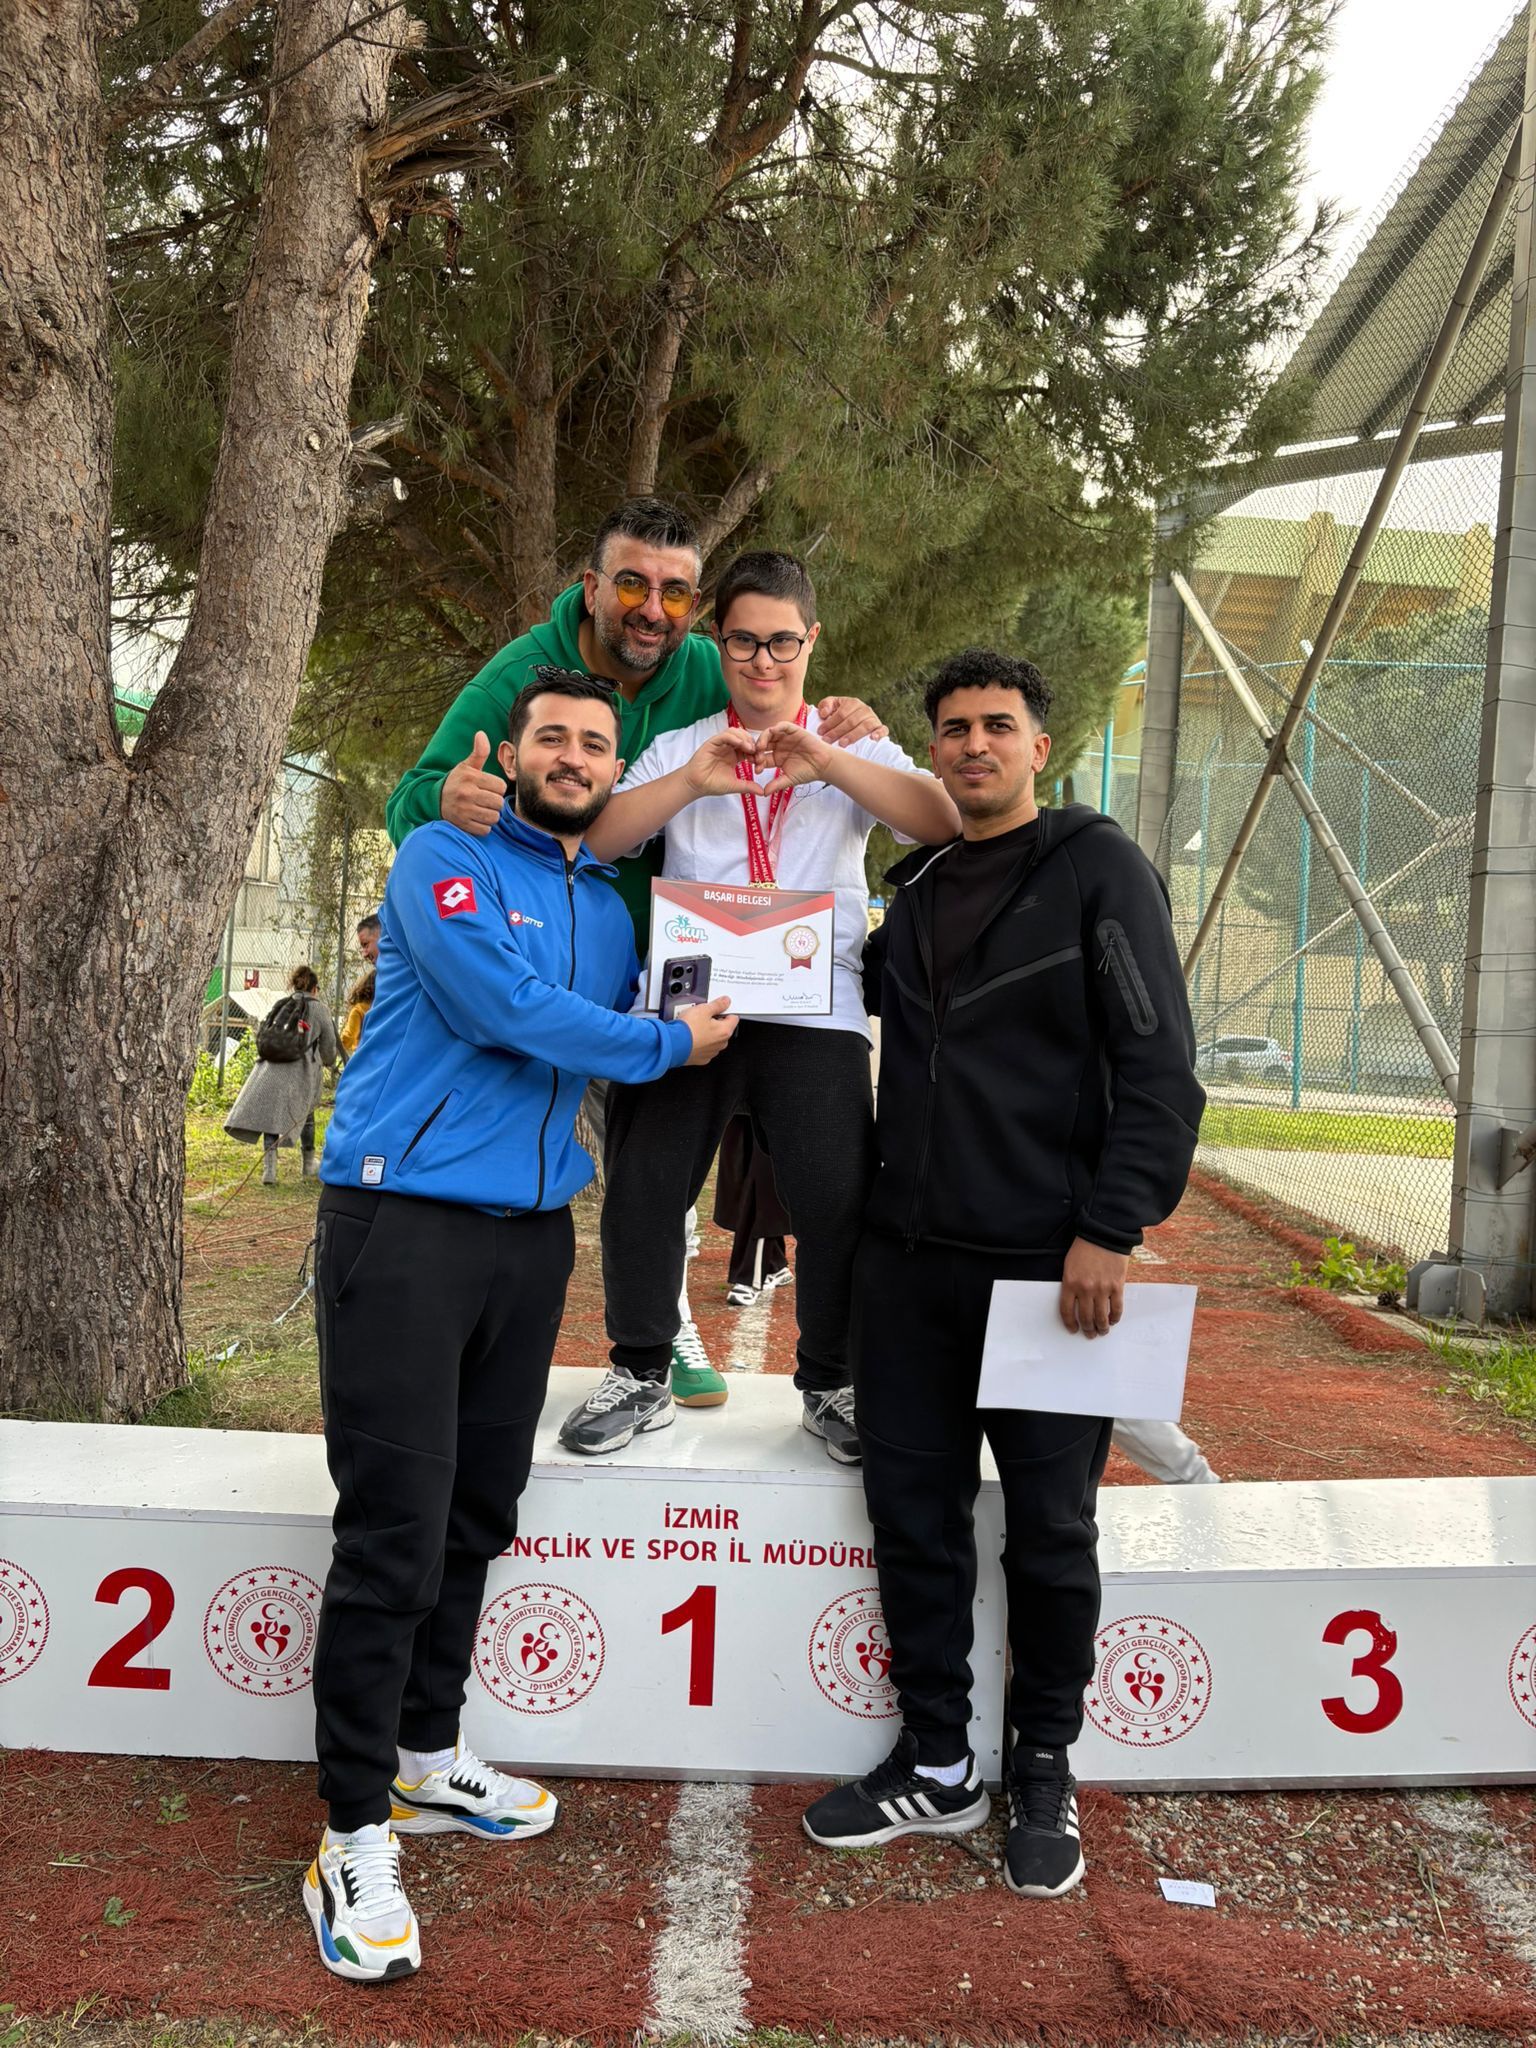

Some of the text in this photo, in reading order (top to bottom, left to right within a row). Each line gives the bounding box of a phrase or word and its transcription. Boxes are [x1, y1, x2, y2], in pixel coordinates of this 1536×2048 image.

[753, 831, 763, 849] SPOR
[522, 915, 544, 928] LOTTO
[703, 890, 771, 906] BAŞARI BELGESİ
[664, 1502, 739, 1530] İZMİR
[500, 1532, 592, 1563] NÇLİK
[602, 1537, 635, 1559] VE
[647, 1538, 717, 1561] SPOR
[730, 1537, 751, 1563] İL
[7, 1590, 18, 1602] VE
[14, 1601, 25, 1624] SPOR
[87, 1567, 175, 1690] 2
[228, 1589, 314, 1671] TÜRKİYE CUMHURİYETİ GENÇLİK VE SPOR BAKANLIĞI
[496, 1606, 581, 1691] TÜRKİYE CUMHURİYETİ GENÇLİK VE SPOR BAKANLIĞI
[661, 1585, 717, 1707] 1
[833, 1611, 866, 1692] TÜRKİYE CUMHURİYETİ
[1321, 1609, 1404, 1734] 3
[1102, 1639, 1188, 1721] TÜRKİYE CUMHURİYETİ GENÇLİK VE SPOR BAKANLIĞI
[1035, 1752, 1054, 1760] adidas
